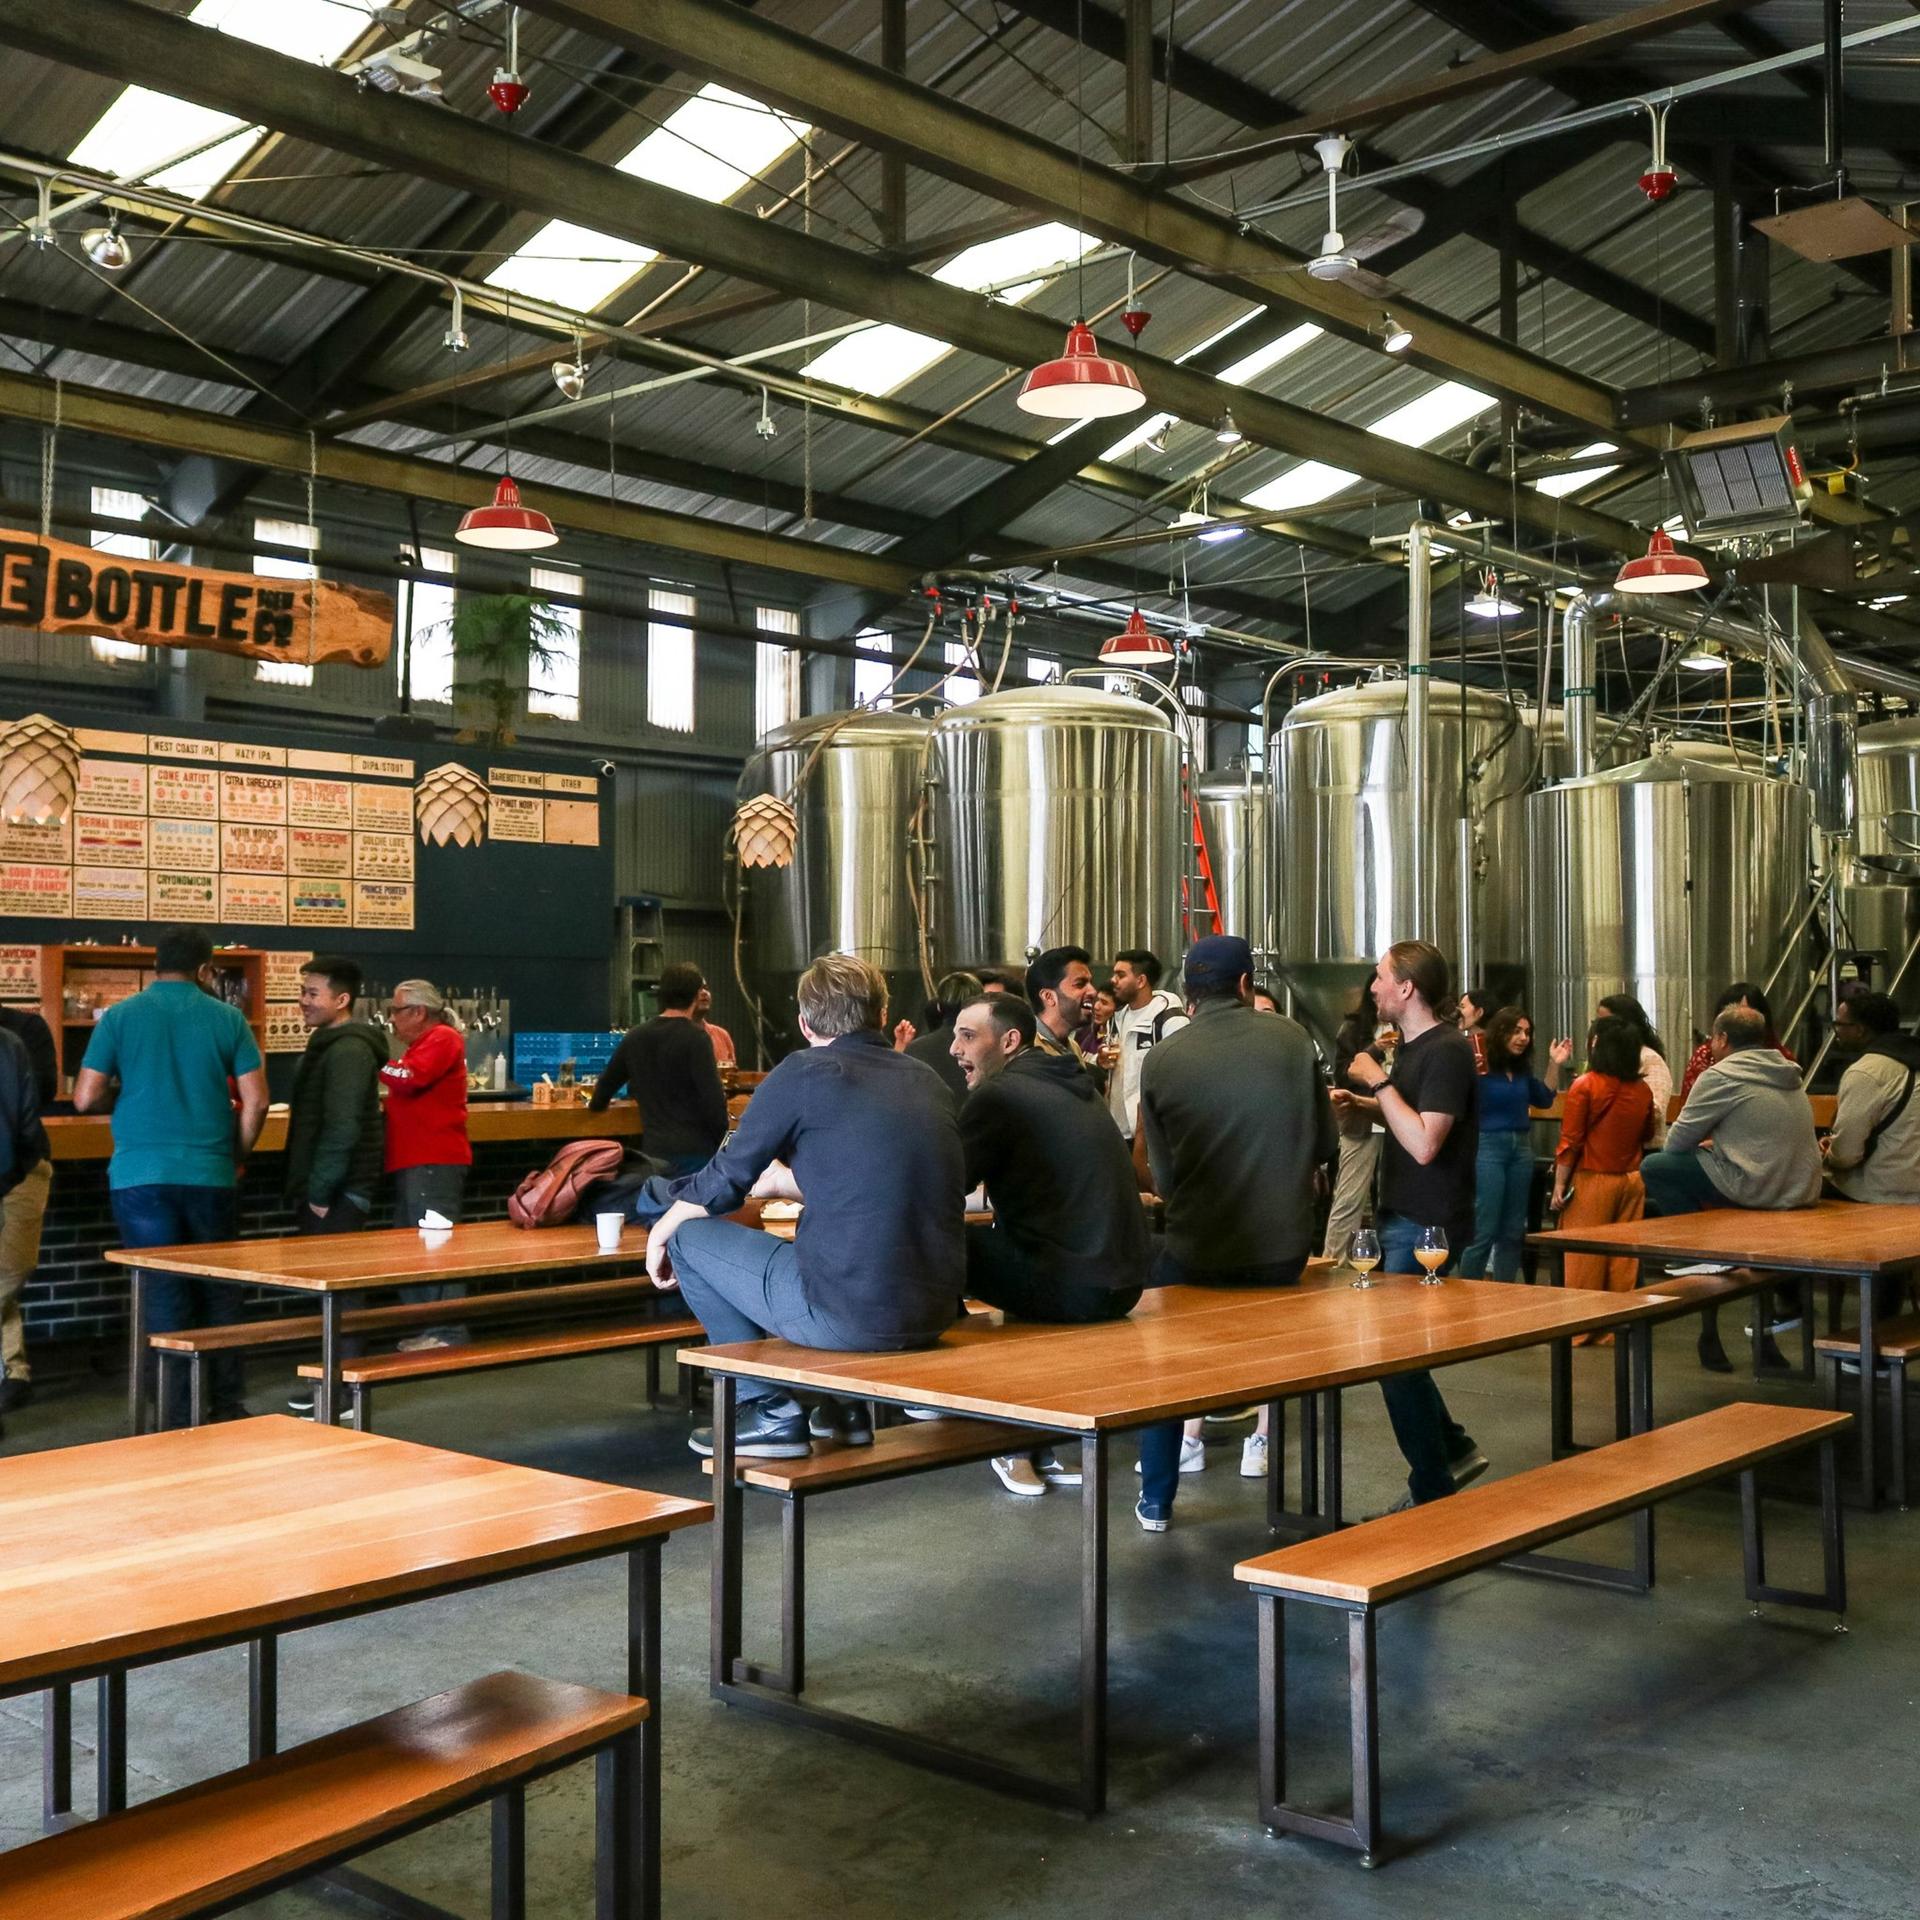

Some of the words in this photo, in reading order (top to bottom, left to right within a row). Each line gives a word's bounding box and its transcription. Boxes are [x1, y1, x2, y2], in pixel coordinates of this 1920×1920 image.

[1789, 445, 1803, 483] Dayton
[55, 559, 254, 641] BOTTLE
[154, 741, 173, 752] WEST
[176, 743, 198, 754] COAST
[201, 745, 214, 756] IPA
[235, 749, 256, 760] HAZY
[258, 750, 271, 761] IPA
[183, 772, 210, 784] ARTIST
[225, 775, 244, 786] CITRA
[246, 776, 282, 789] SHREDDER
[490, 771, 527, 784] BAREBOTTLE
[528, 776, 542, 786] WINE
[561, 778, 582, 789] OTHER
[502, 798, 517, 810] PINOT
[518, 799, 533, 810] NOIR
[157, 874, 212, 887] CRYONOMICON
